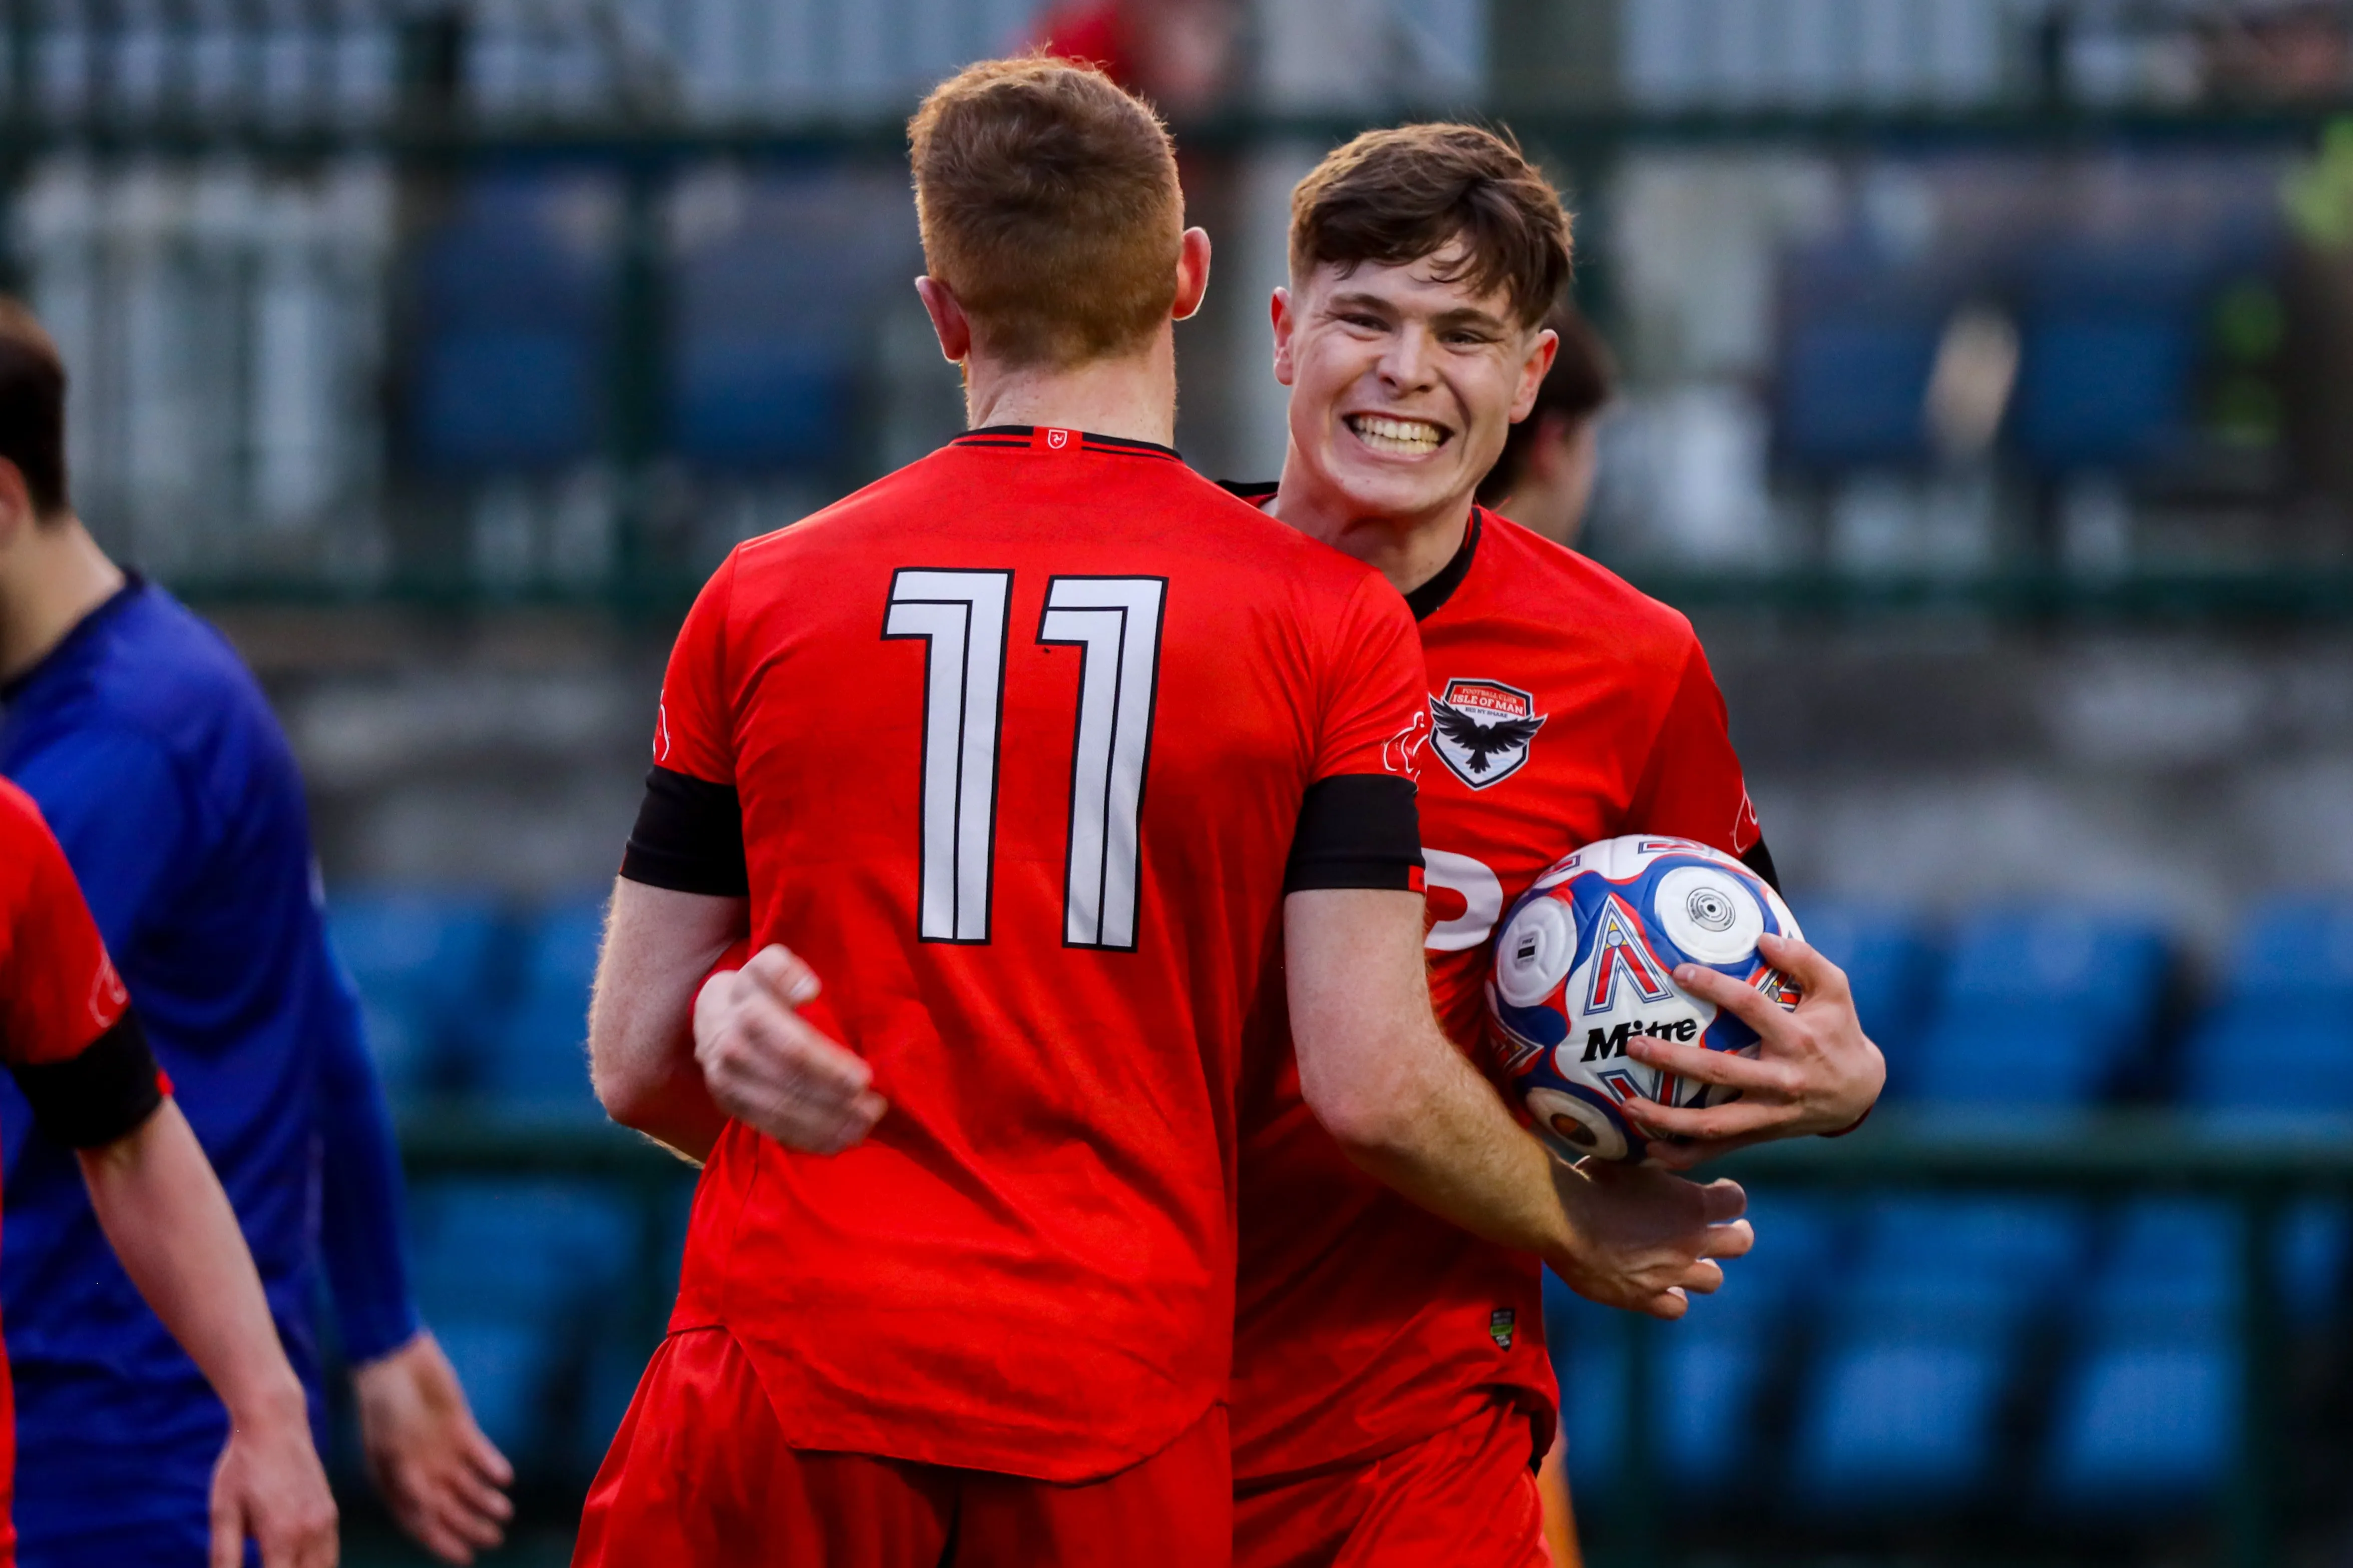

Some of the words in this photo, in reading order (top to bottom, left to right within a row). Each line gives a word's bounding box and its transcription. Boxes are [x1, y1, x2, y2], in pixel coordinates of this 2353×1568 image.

[1453, 694, 1478, 705] ISLE
[1479, 697, 1495, 707] OF
[1495, 700, 1523, 715] MAN
[1462, 688, 1497, 699] FOOTBALL
[1498, 693, 1517, 704] CLUB
[881, 567, 1169, 953] 11
[1580, 1018, 1698, 1063] Mitre
